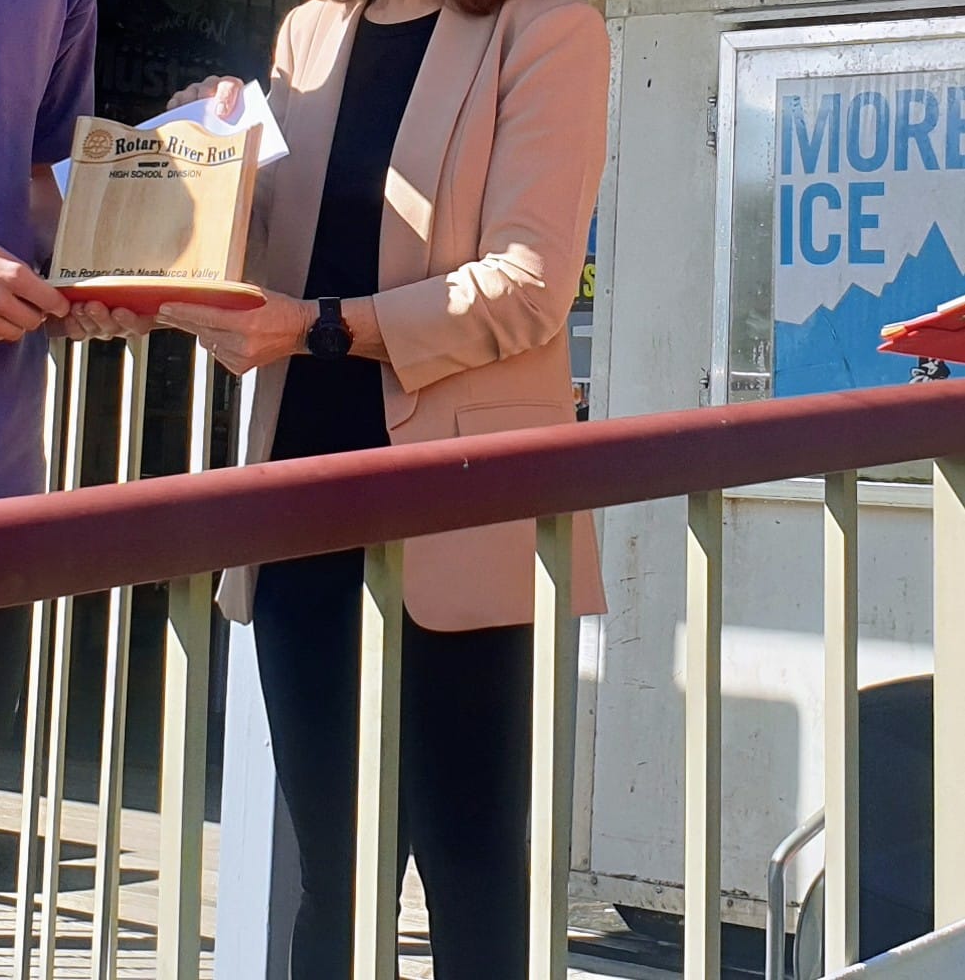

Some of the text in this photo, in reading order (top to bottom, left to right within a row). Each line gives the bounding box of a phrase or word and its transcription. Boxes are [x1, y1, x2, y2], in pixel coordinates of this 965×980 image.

[115, 135, 237, 163] Rotary River Run
[109, 169, 203, 179] HIGH SCHOOL DIVISION
[780, 181, 885, 266] ICE
[59, 268, 77, 278] The
[78, 268, 112, 278] Rotary
[191, 268, 220, 280] Valley
